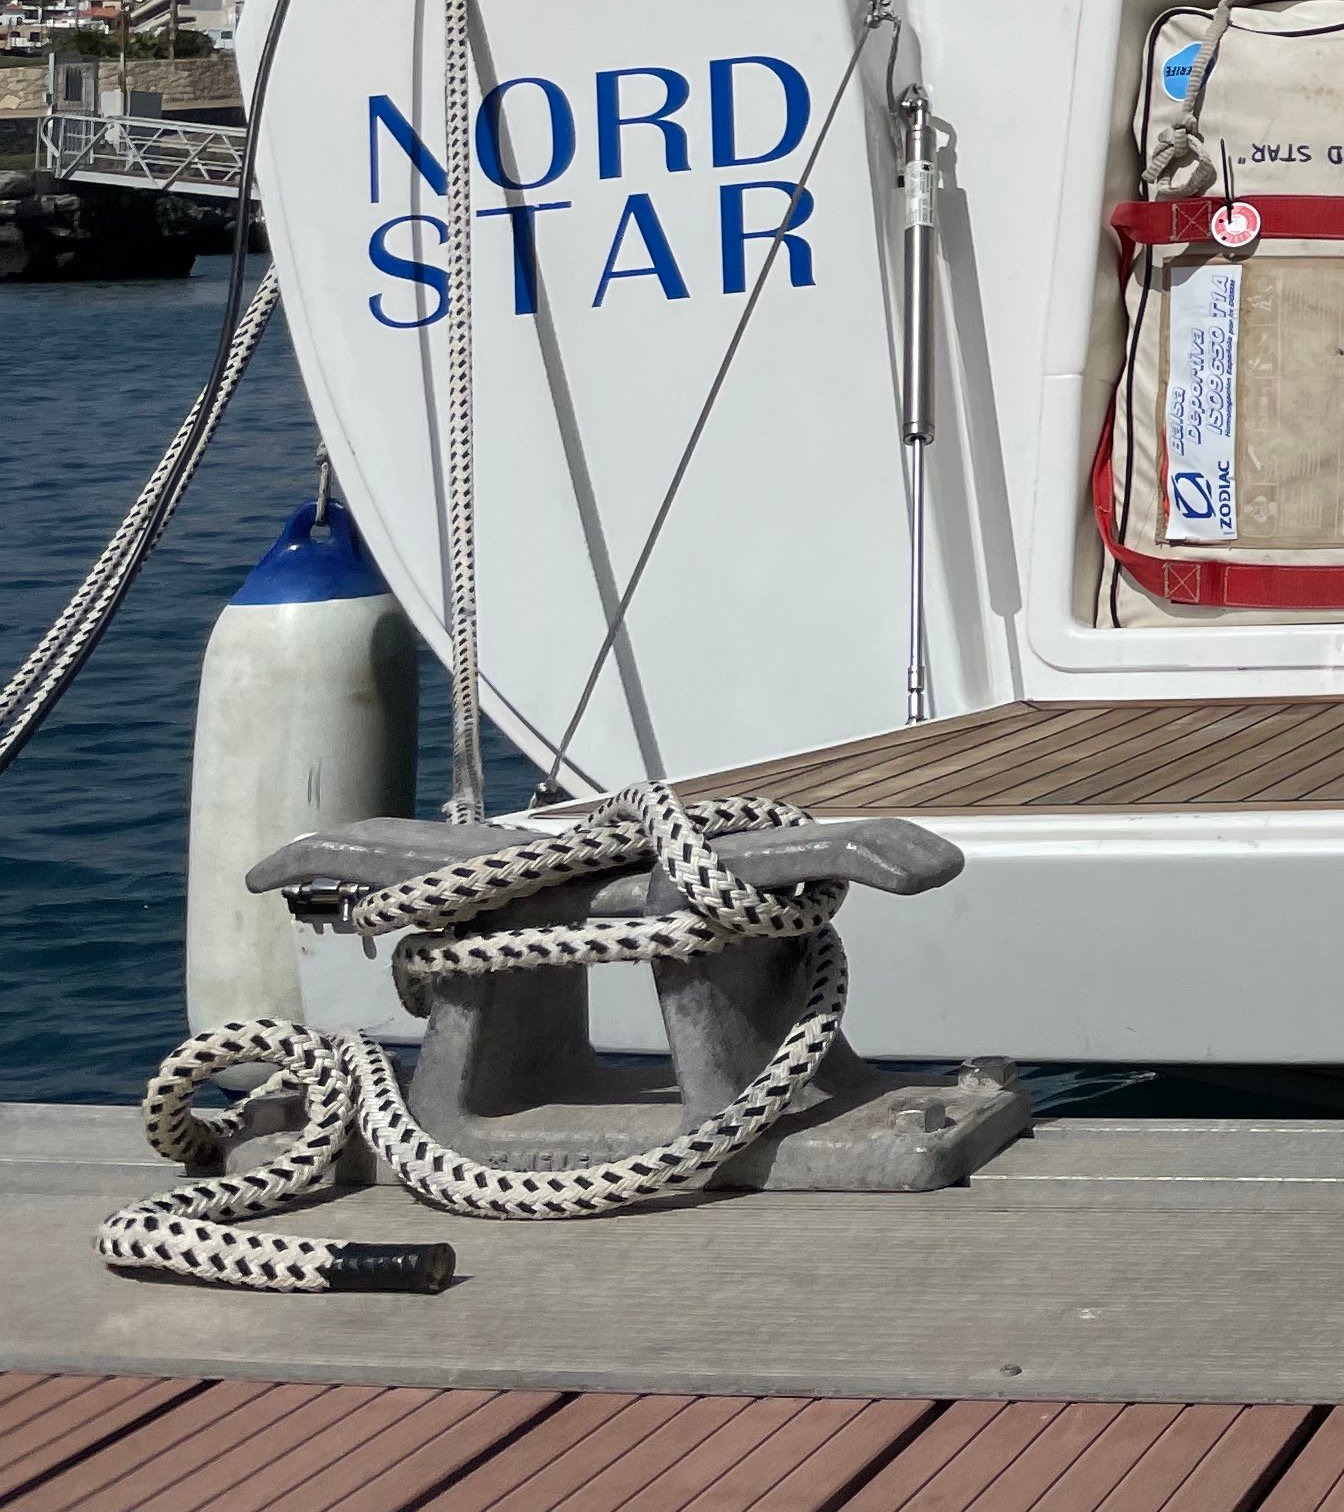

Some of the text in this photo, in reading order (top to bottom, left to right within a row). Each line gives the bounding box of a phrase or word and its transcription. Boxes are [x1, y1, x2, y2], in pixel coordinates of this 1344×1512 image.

[368, 55, 811, 204] NORD
[368, 180, 816, 329] STAR
[1168, 386, 1185, 456] Balsa
[1185, 328, 1206, 445] Deportiva
[1206, 274, 1229, 436] ISO9650 T1A
[1217, 460, 1232, 530] ZODIAC
